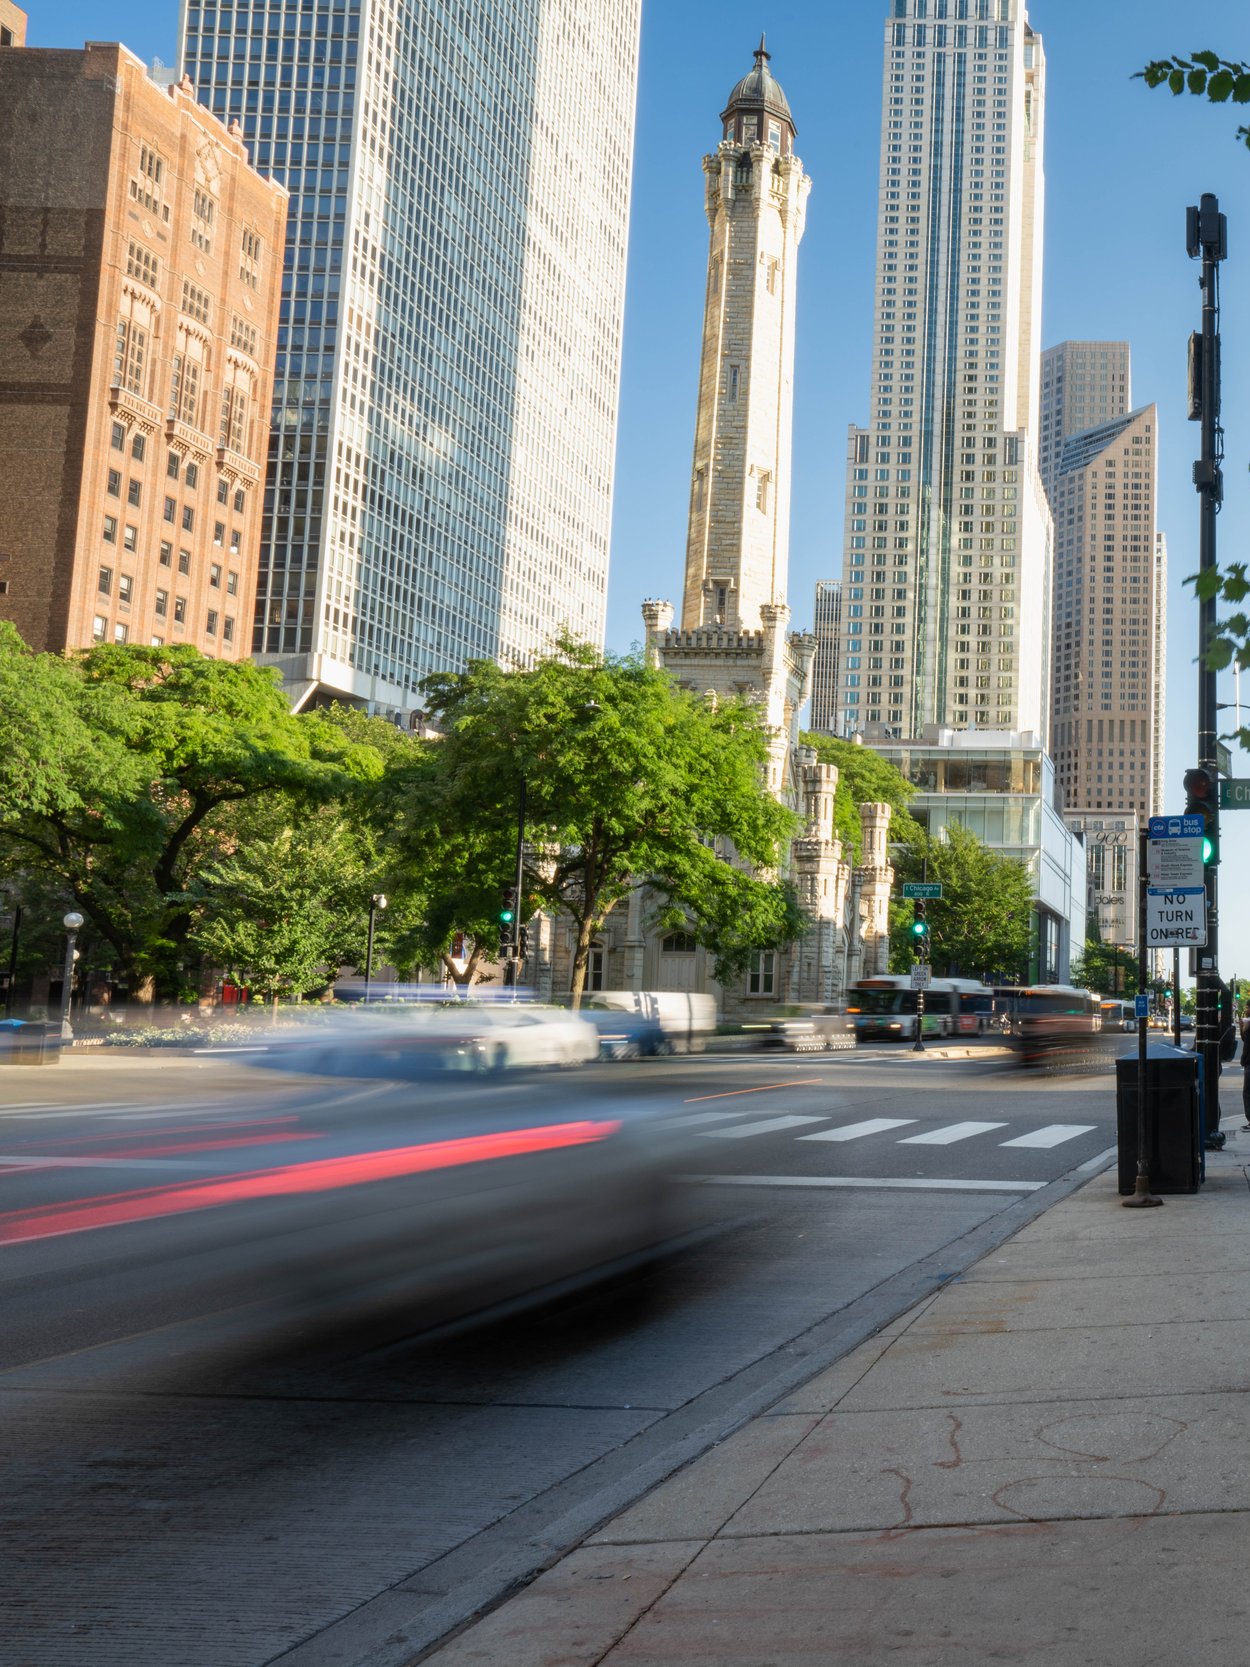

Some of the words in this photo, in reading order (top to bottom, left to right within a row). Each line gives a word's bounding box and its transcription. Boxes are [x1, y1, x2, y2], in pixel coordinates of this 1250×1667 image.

[1226, 789, 1230, 798] E
[1184, 818, 1198, 826] bus
[1184, 827, 1201, 835] stop
[1096, 832, 1127, 845] 900
[1164, 894, 1186, 905] NO
[1158, 911, 1193, 922] TURN
[1151, 929, 1168, 939] ON
